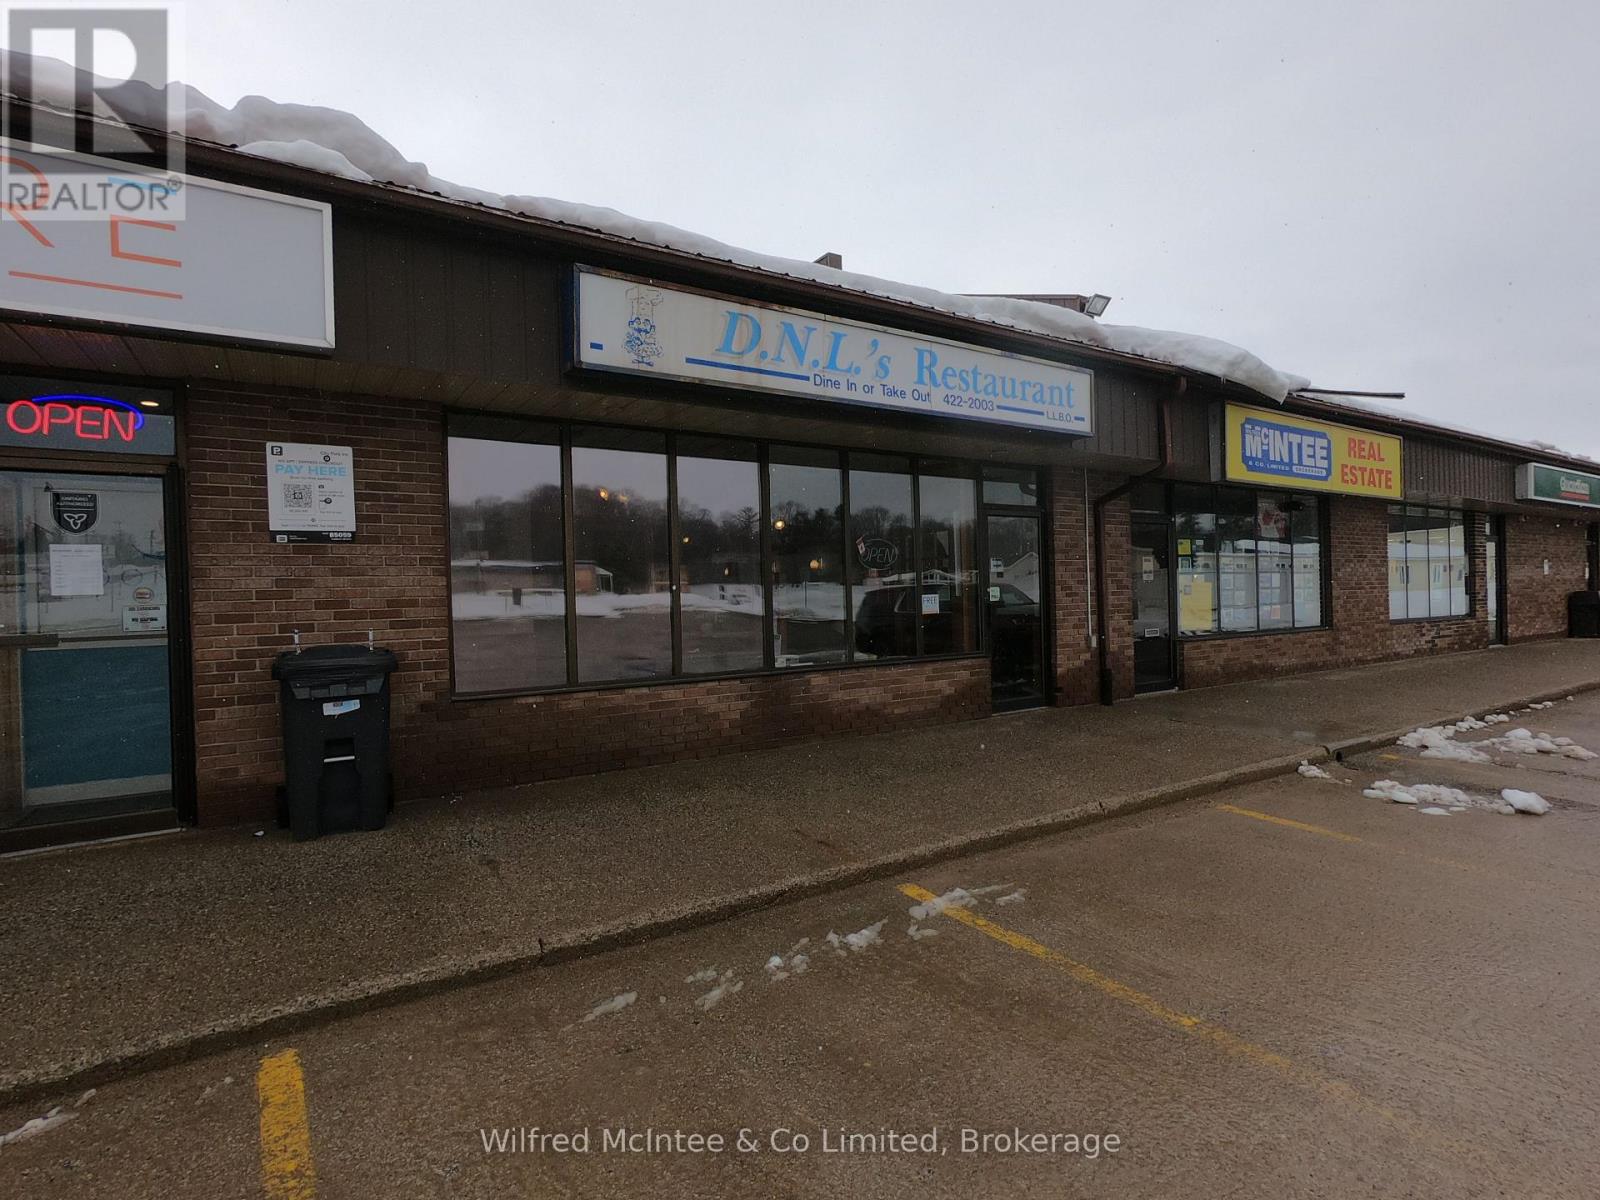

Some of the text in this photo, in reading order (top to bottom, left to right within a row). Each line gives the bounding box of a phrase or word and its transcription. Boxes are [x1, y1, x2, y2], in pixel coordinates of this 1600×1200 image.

[913, 347, 1075, 409] Restaurant
[813, 373, 994, 411] Dine In or Take Out 422-2003
[6, 400, 136, 442] OPEN
[1347, 437, 1385, 462] REAL
[275, 464, 347, 476] PAY HERE
[1340, 463, 1393, 490] ESTATE
[863, 547, 895, 563] OPEN
